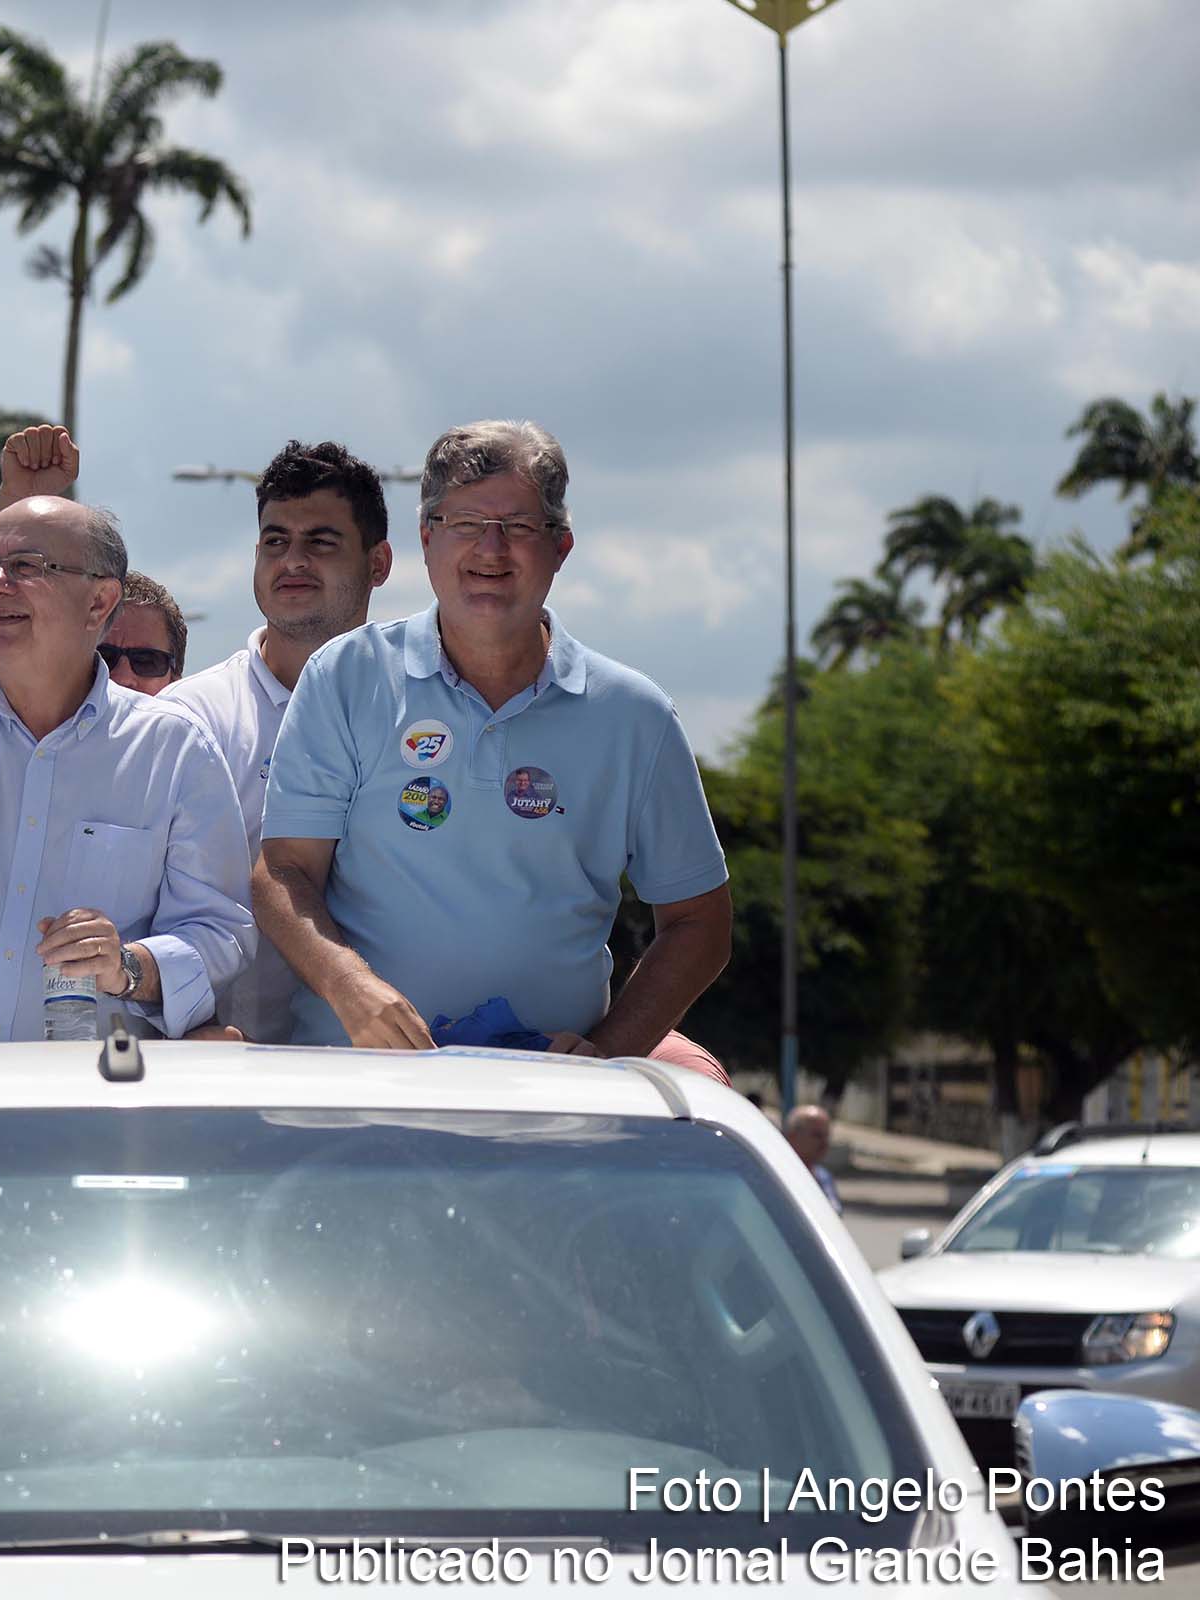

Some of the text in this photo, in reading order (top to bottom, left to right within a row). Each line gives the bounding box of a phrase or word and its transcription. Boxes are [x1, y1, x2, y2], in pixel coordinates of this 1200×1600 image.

[417, 736, 442, 754] 25
[403, 791, 427, 802] 200
[511, 797, 552, 808] JUTAHY
